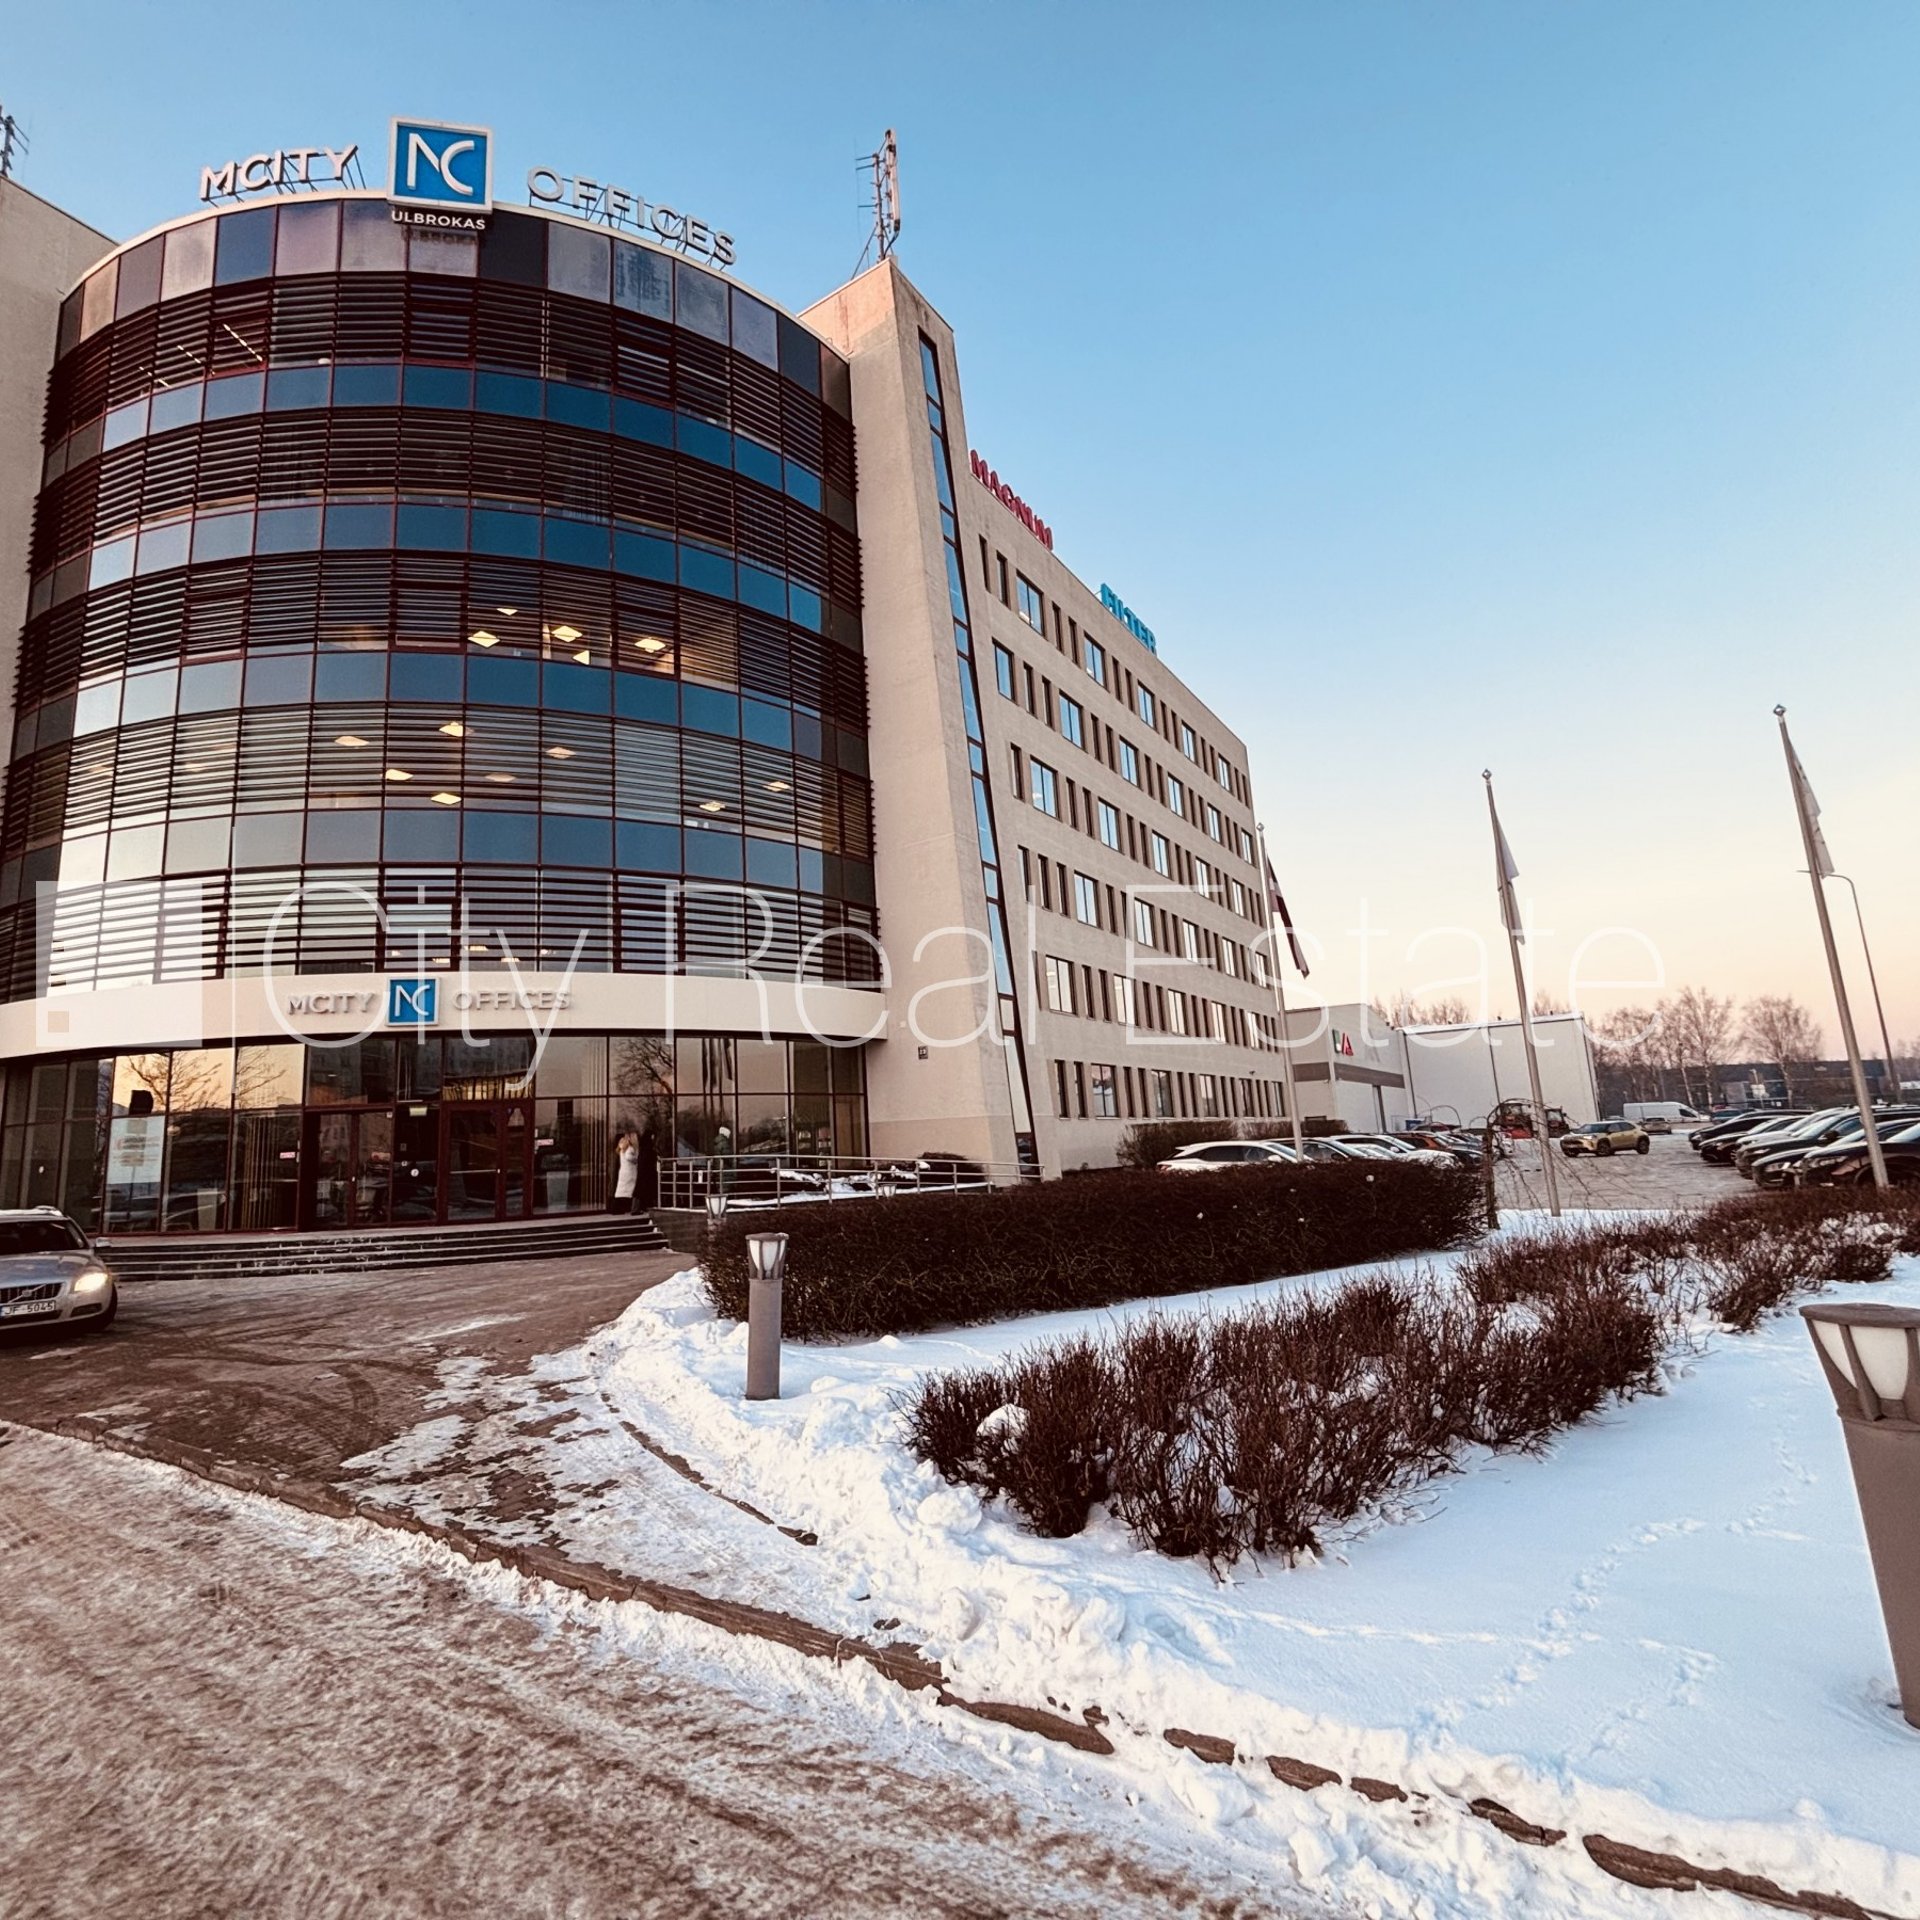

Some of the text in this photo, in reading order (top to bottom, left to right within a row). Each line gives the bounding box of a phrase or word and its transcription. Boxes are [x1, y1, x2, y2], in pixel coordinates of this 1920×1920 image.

[200, 145, 358, 200] MCITY
[391, 210, 486, 230] ULBROKAS
[527, 165, 737, 265] OFFICES
[970, 449, 1053, 550] MAGNUM
[288, 991, 374, 1015] MCITY
[453, 990, 570, 1011] OFFICES
